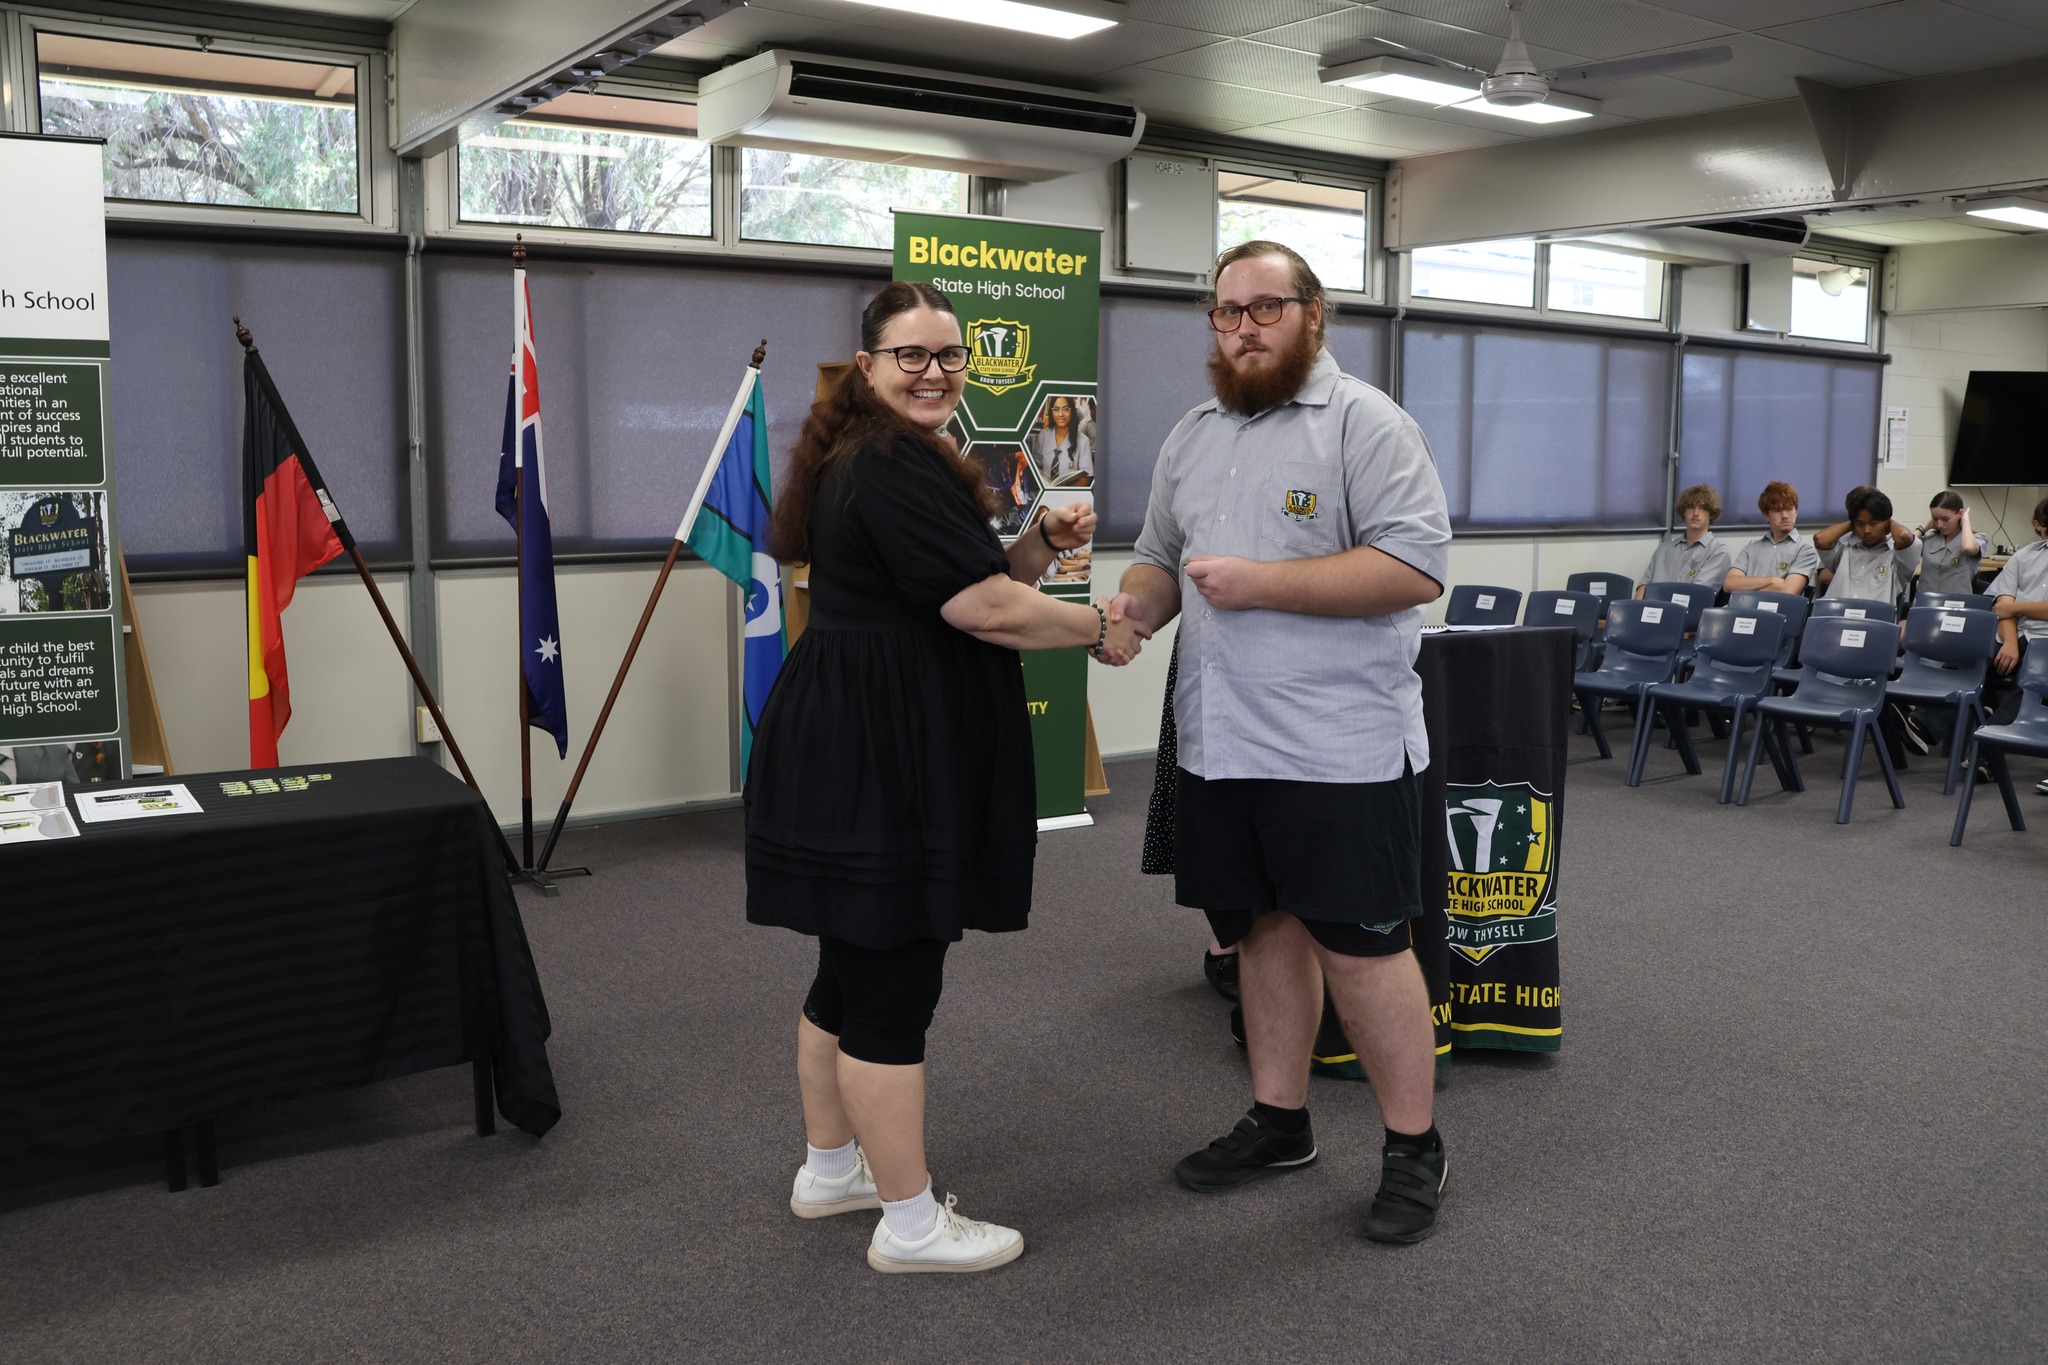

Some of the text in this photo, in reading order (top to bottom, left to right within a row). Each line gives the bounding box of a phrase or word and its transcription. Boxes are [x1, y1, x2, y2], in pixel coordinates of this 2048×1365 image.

[910, 236, 1087, 275] Blackwater
[932, 277, 1064, 299] State High School
[24, 291, 94, 310] School
[977, 358, 1019, 367] BLACKWATER
[10, 372, 67, 383] excellent
[35, 397, 46, 408] in
[52, 400, 67, 408] an
[0, 409, 80, 420] nt of success
[0, 422, 60, 435] pires and
[11, 434, 65, 445] students
[69, 435, 83, 445] to
[1, 446, 87, 460] full potential.
[14, 528, 88, 545] BLACKWATER
[9, 642, 38, 654] child
[43, 642, 64, 652] the
[68, 640, 95, 651] best
[0, 652, 84, 668] unity to fulfil
[20, 666, 44, 678] and
[49, 666, 94, 676] dreams
[0, 677, 92, 691] future with an
[14, 693, 26, 702] at
[31, 689, 99, 701] Blackwater
[3, 700, 81, 717] High School.
[1487, 899, 1525, 910] SCHOOL
[1474, 924, 1525, 942] THYSELF
[1450, 982, 1506, 1004] STATE
